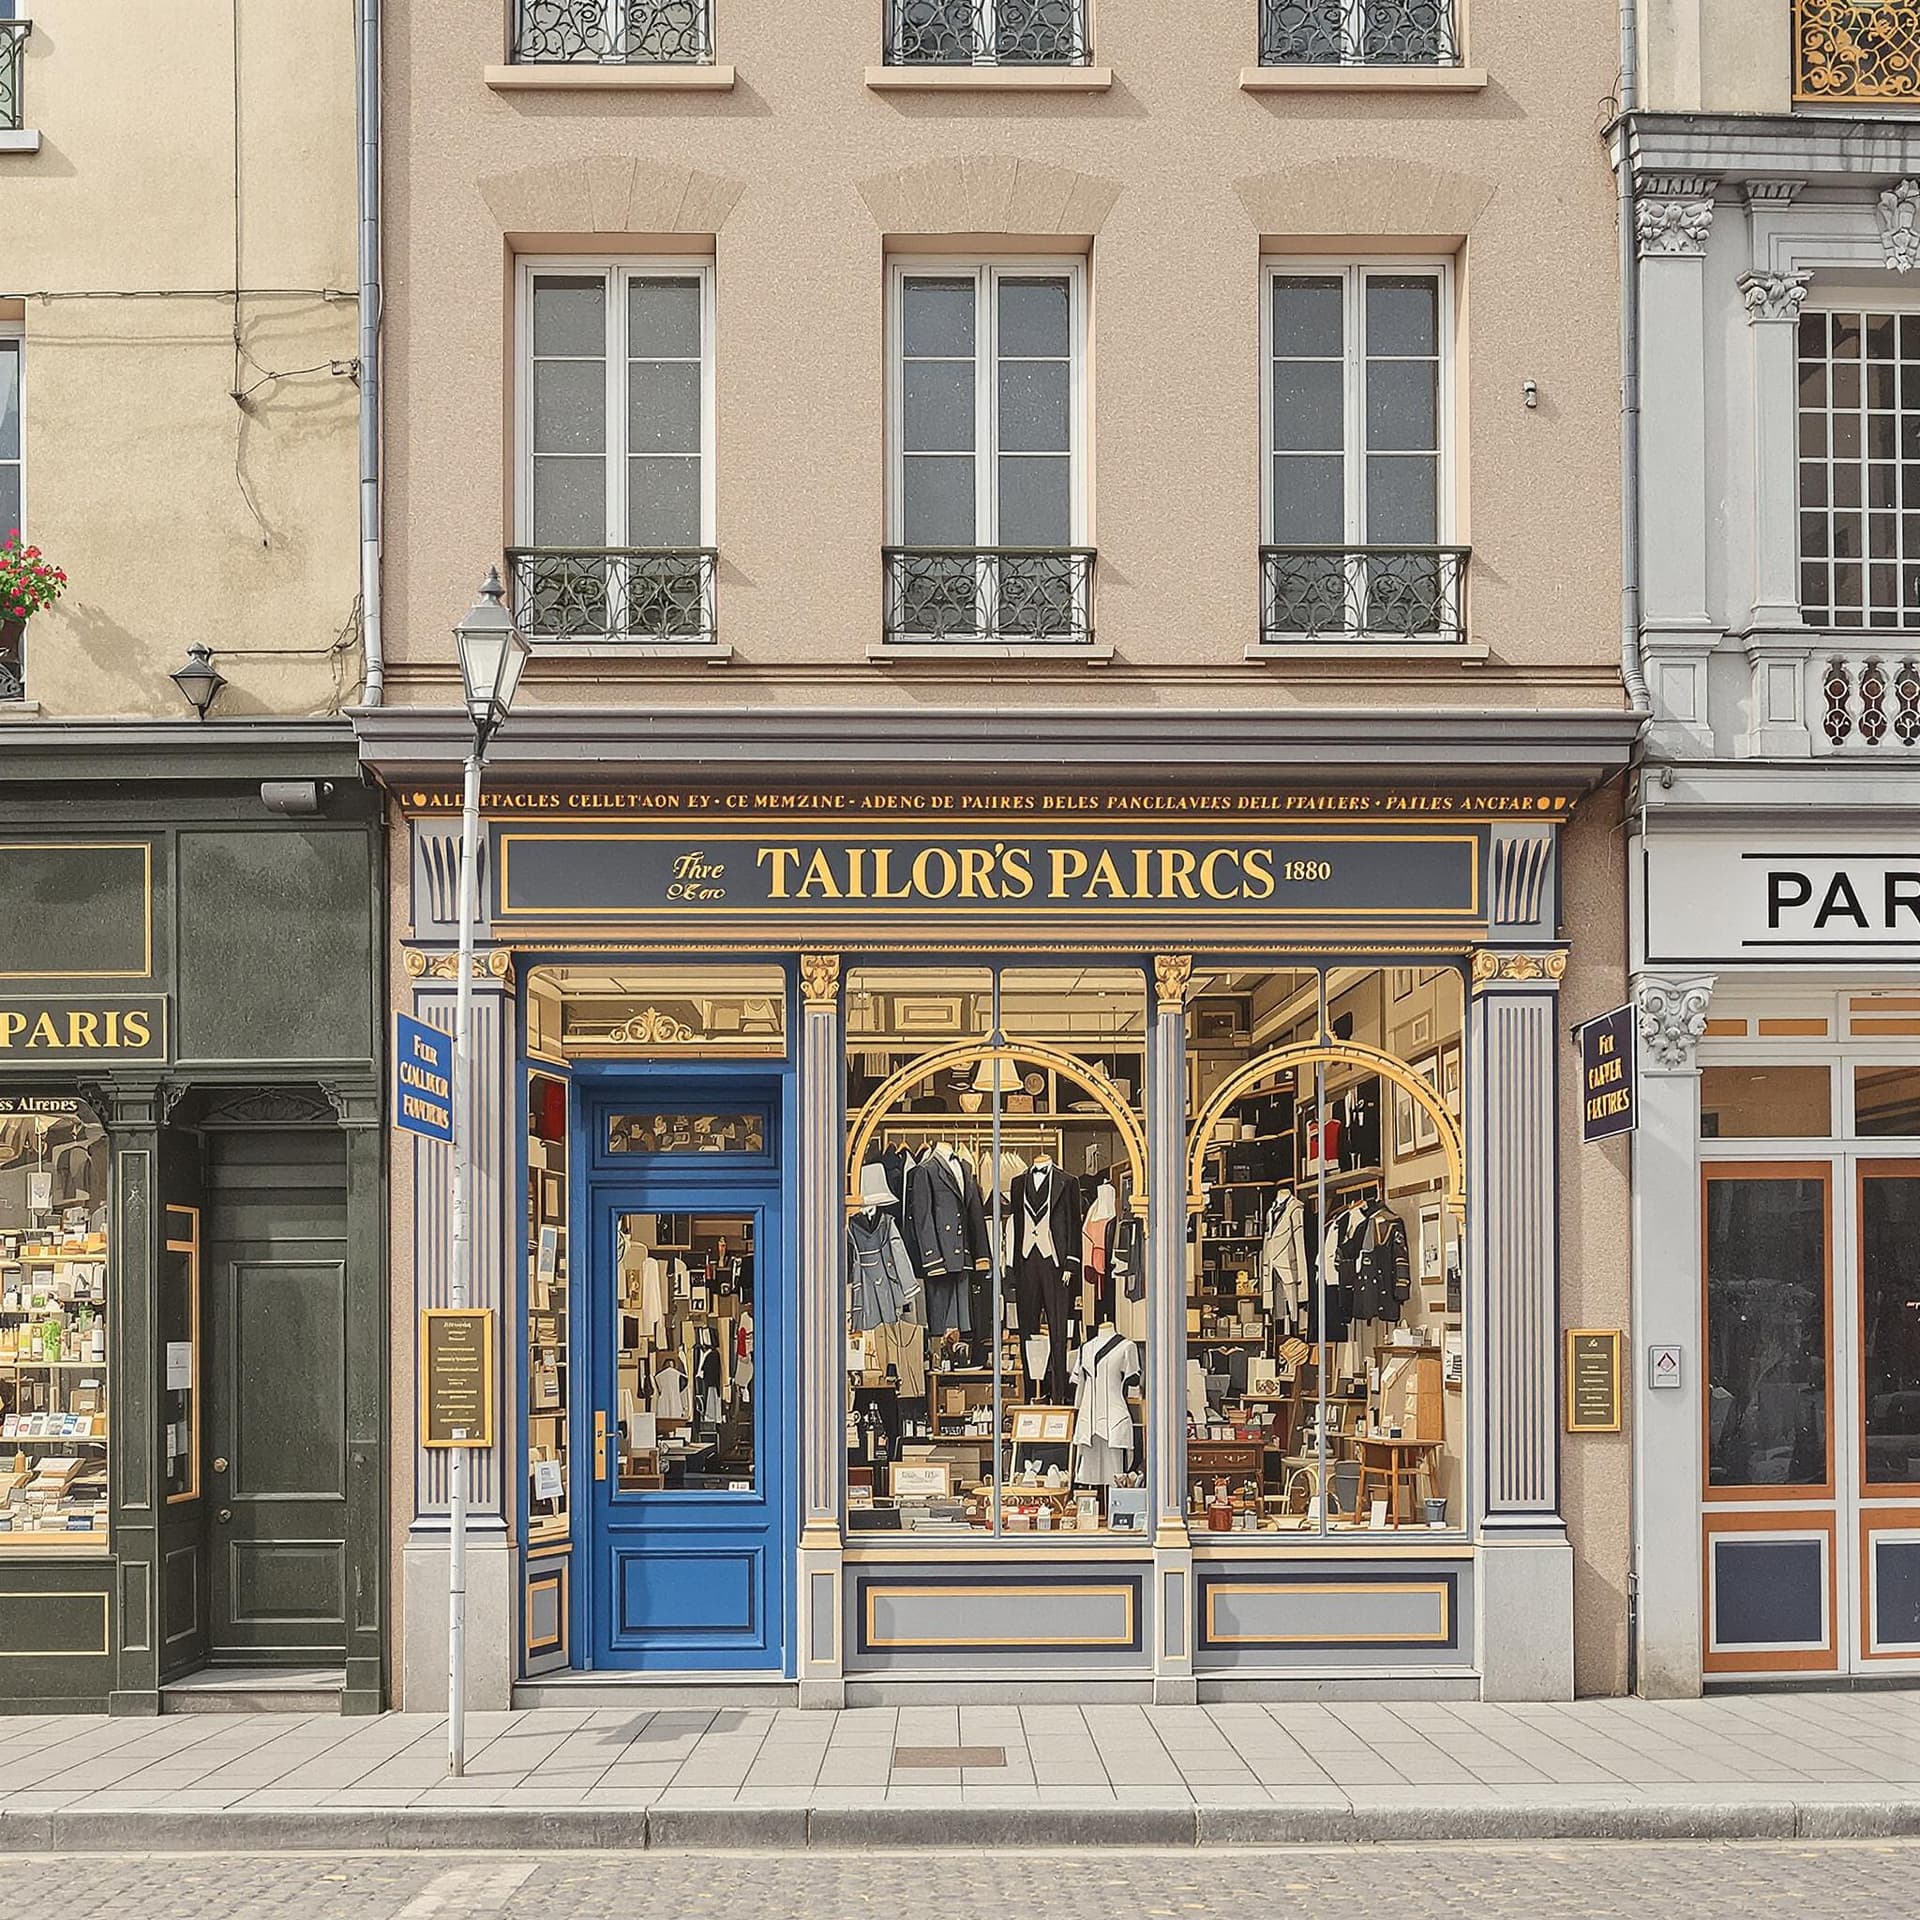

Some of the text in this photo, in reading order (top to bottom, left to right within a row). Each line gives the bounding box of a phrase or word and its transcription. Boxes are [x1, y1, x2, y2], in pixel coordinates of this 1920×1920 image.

[756, 843, 1332, 900] TAILOR'S PAIRCS 1880
[1767, 872, 1920, 928] PAR
[0, 1010, 151, 1049] PARIS
